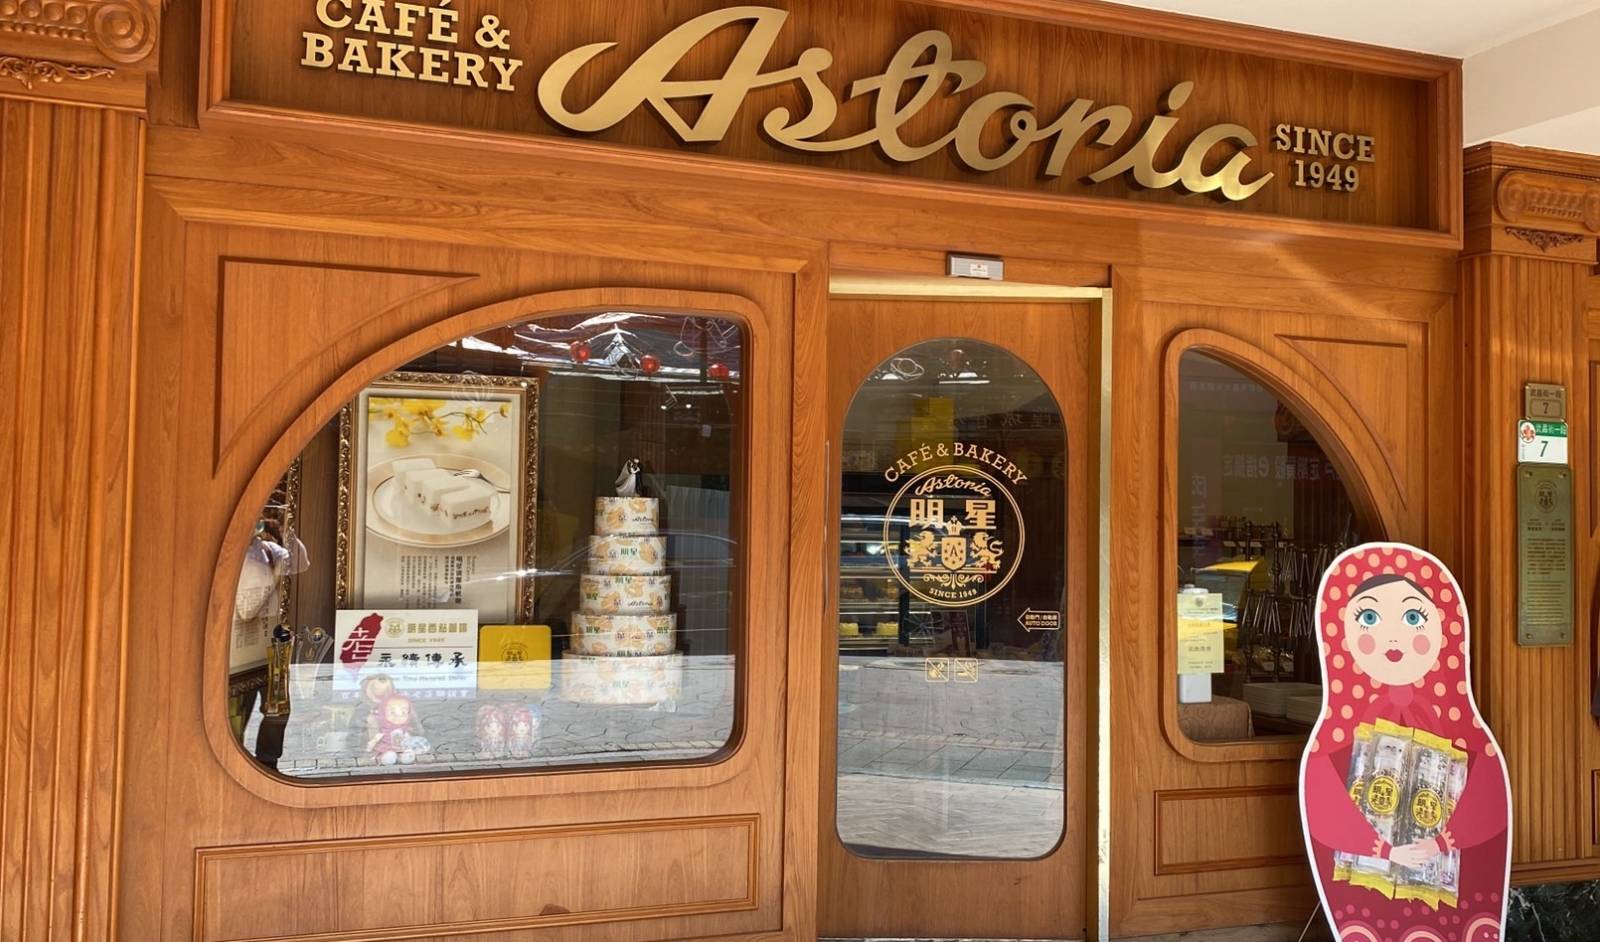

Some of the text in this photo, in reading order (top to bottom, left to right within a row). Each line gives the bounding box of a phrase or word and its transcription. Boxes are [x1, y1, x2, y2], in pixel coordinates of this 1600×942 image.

[316, 0, 510, 50] CAFÉ &
[301, 31, 524, 91] BAKERY
[537, 6, 1275, 200] Astoria
[1276, 123, 1375, 162] SINCE
[1295, 159, 1359, 192] 1949
[1542, 401, 1549, 414] 7
[885, 442, 1027, 484] CAFÉ & BAKERY
[1540, 440, 1548, 457] 7
[915, 473, 991, 496] Astoria
[909, 498, 997, 529] 明星
[929, 587, 977, 599] SINCE 1949
